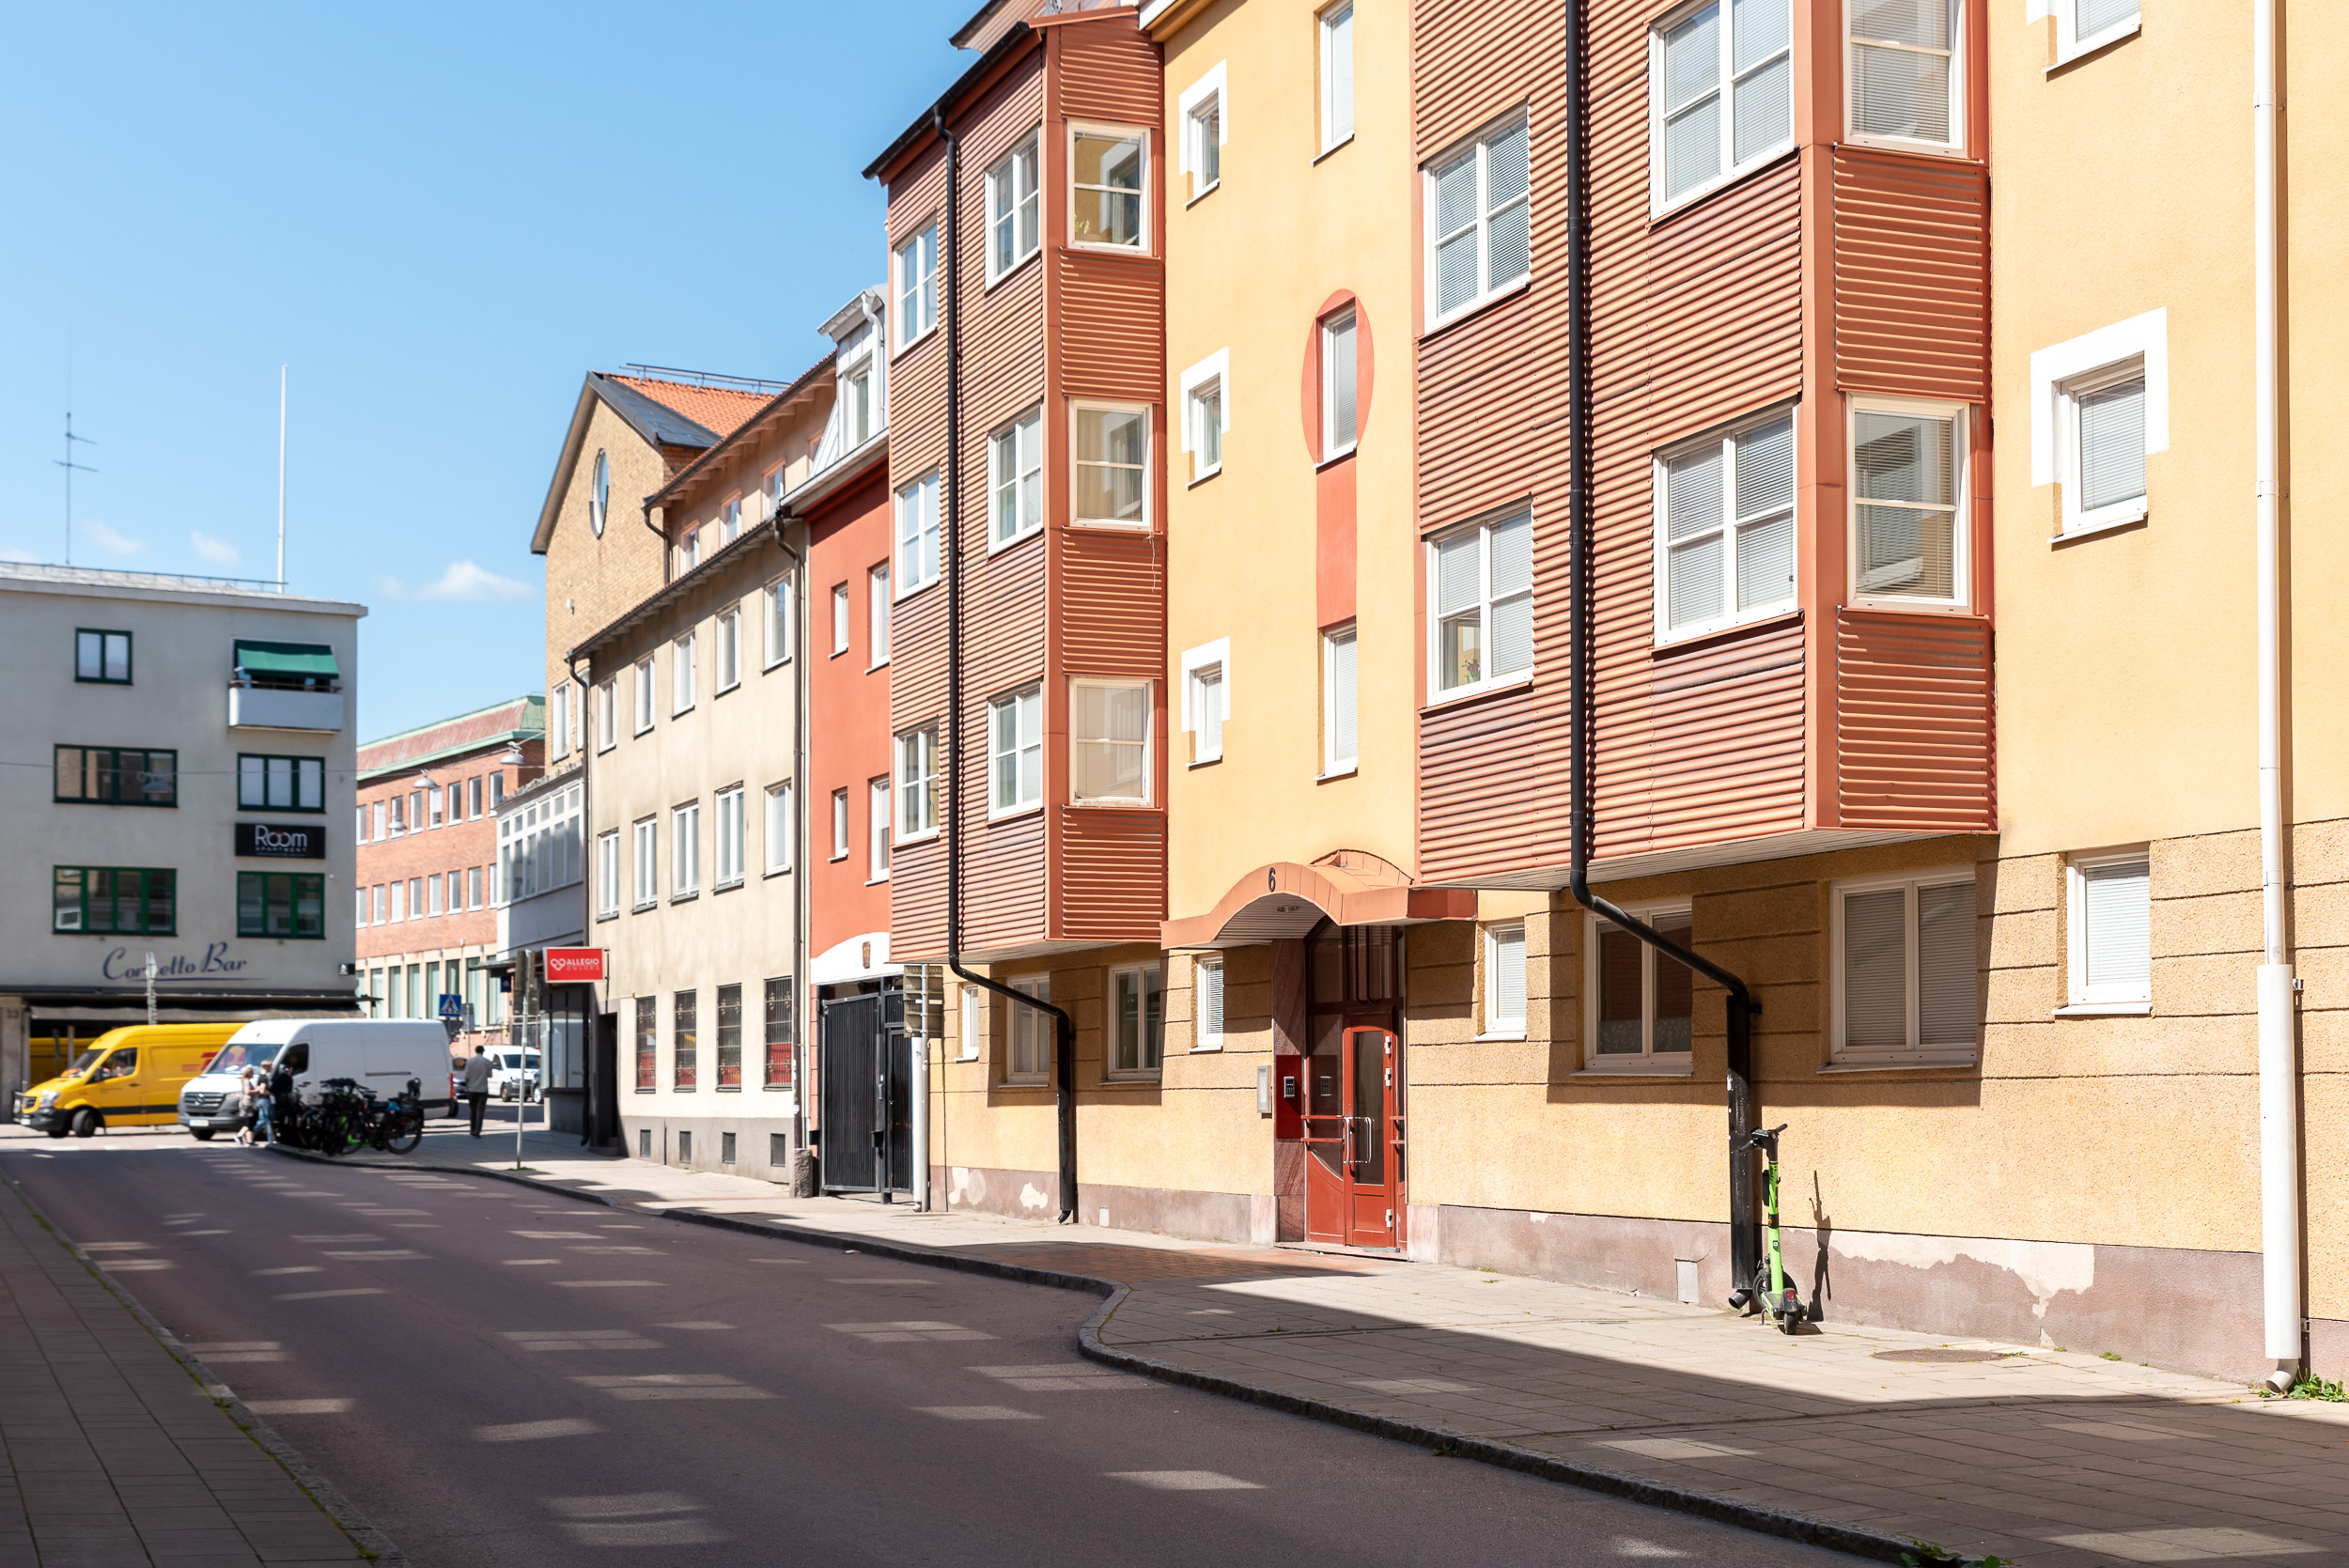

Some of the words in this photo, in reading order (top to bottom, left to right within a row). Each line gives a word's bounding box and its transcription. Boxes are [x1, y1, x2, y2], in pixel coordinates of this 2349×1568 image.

[255, 824, 307, 847] Room
[1268, 867, 1276, 893] 6
[102, 947, 195, 980] Coretto
[200, 941, 248, 972] Bar
